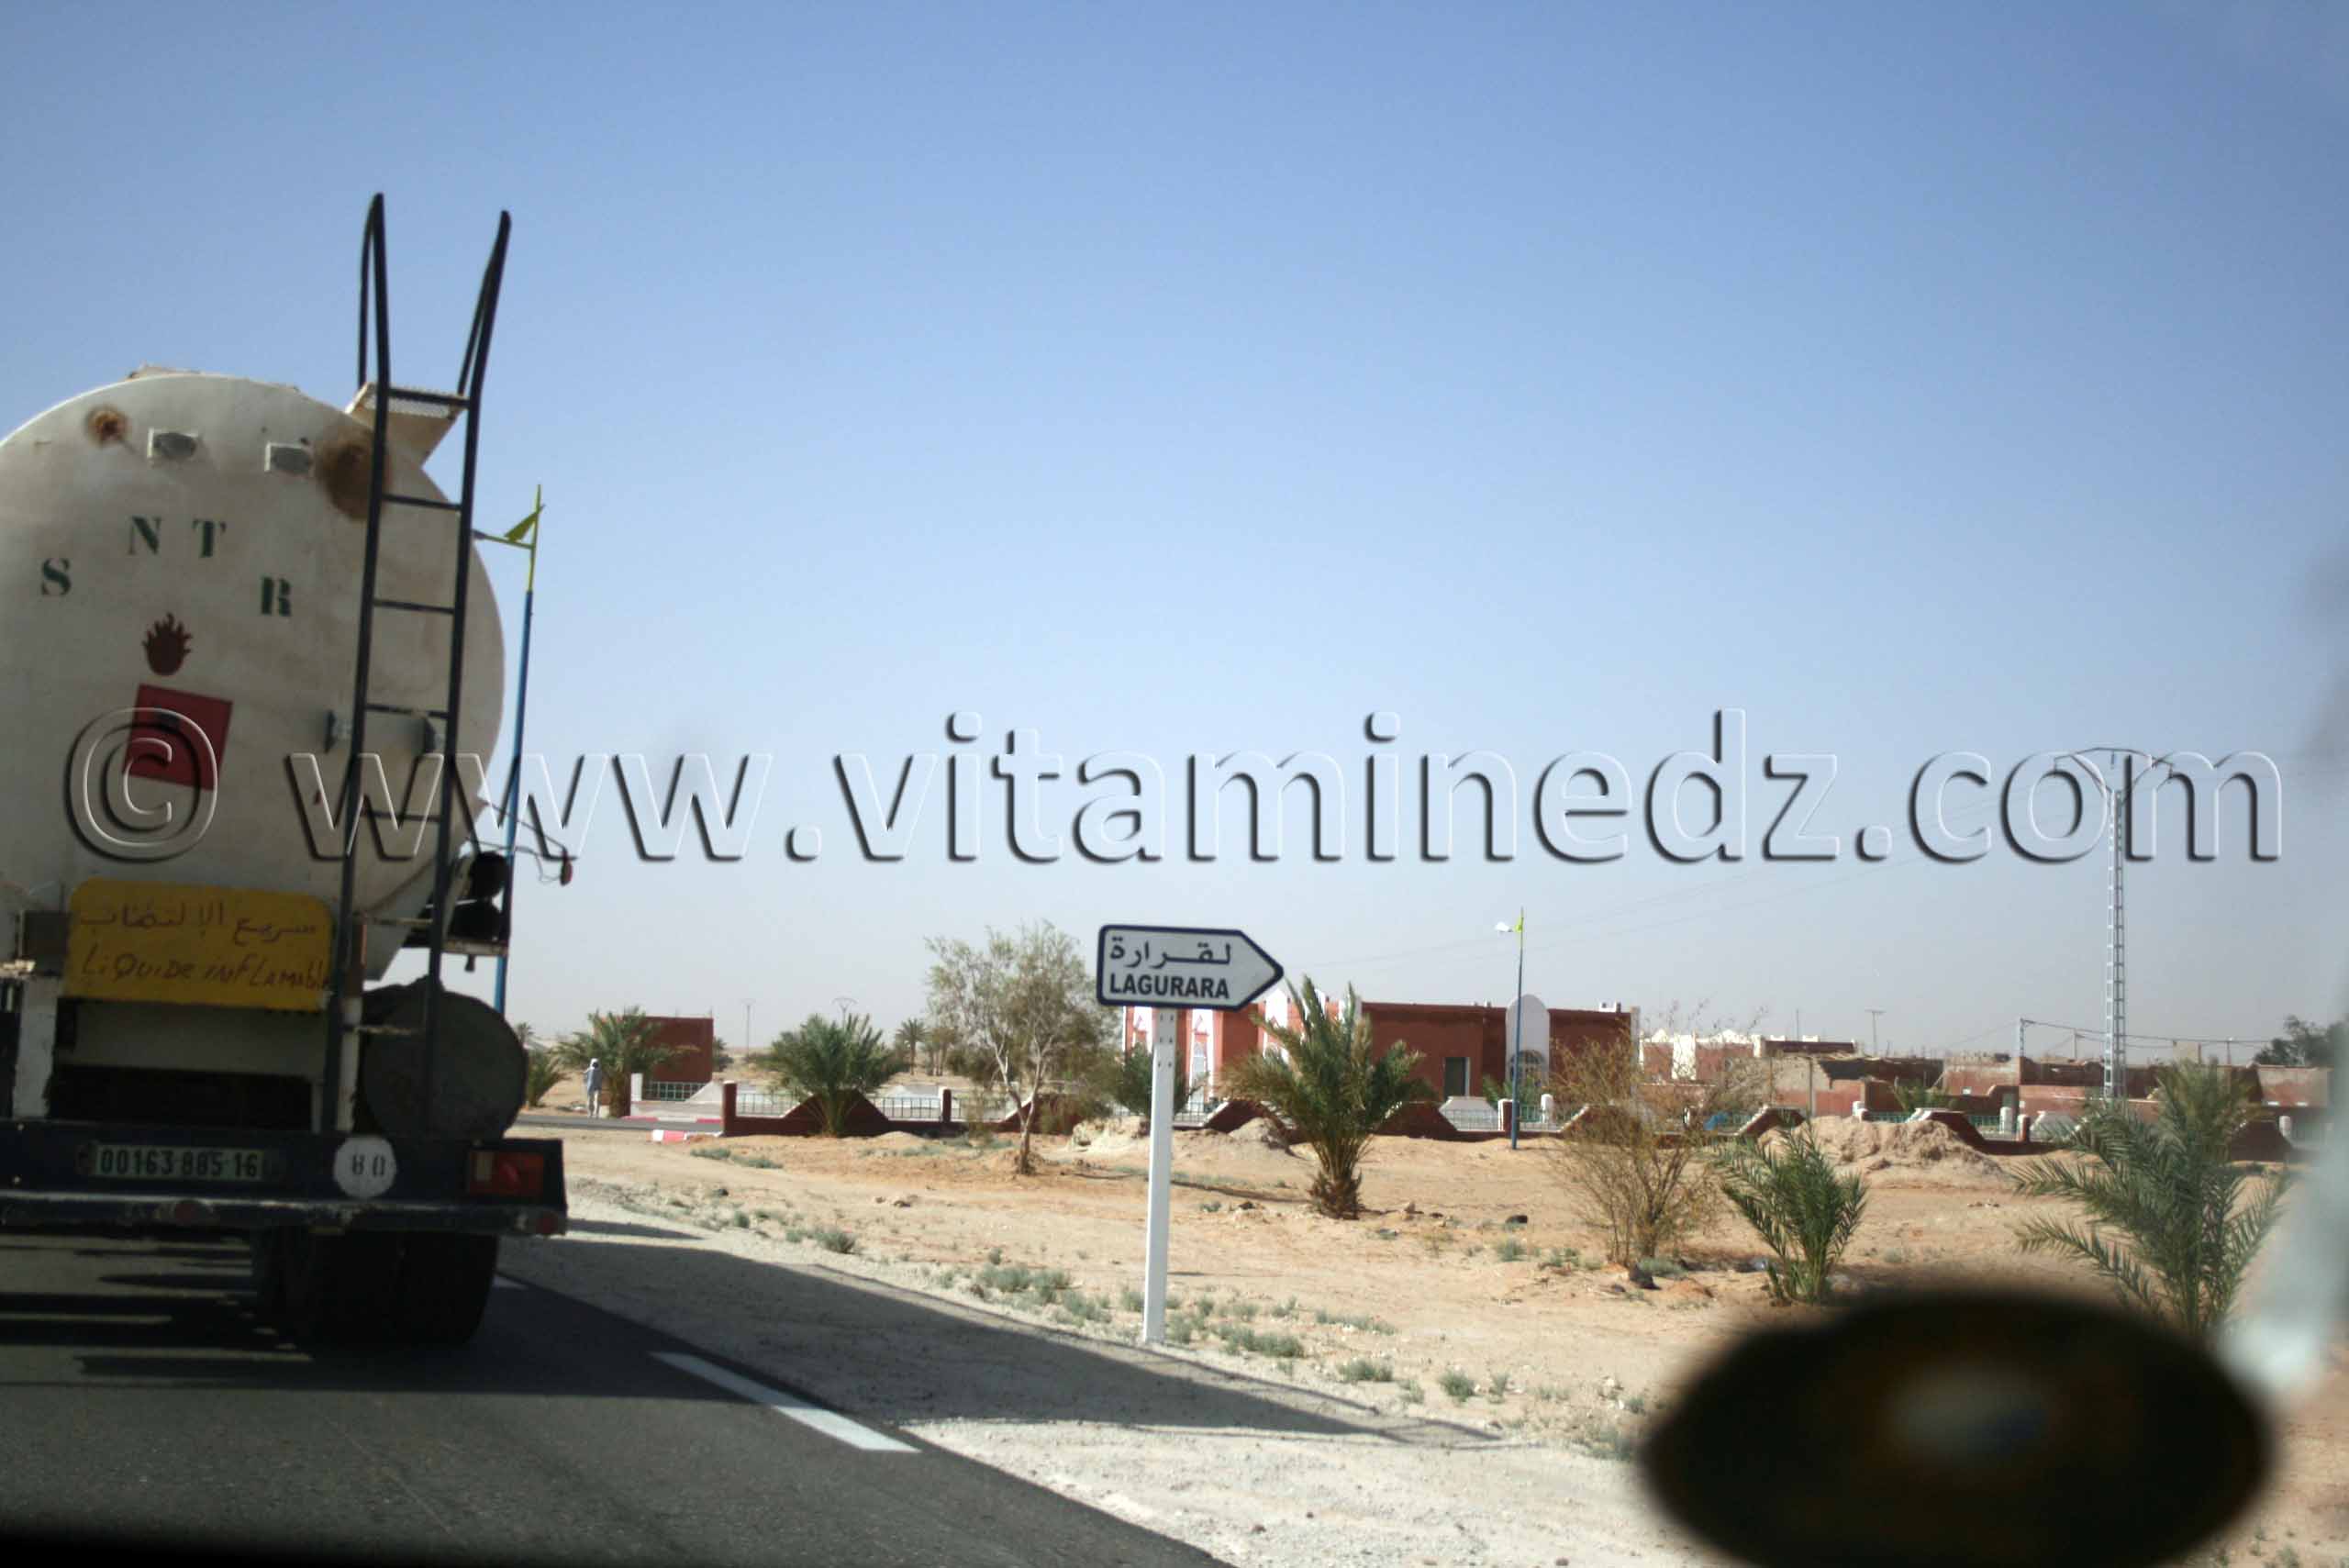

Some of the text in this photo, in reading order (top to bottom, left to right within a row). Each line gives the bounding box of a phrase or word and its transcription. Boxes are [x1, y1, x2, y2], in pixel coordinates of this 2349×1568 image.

[1109, 936, 1231, 970] لقرارة
[1109, 973, 1230, 999] LAGURARA
[100, 1149, 174, 1175] 00163
[234, 1151, 259, 1177] 16
